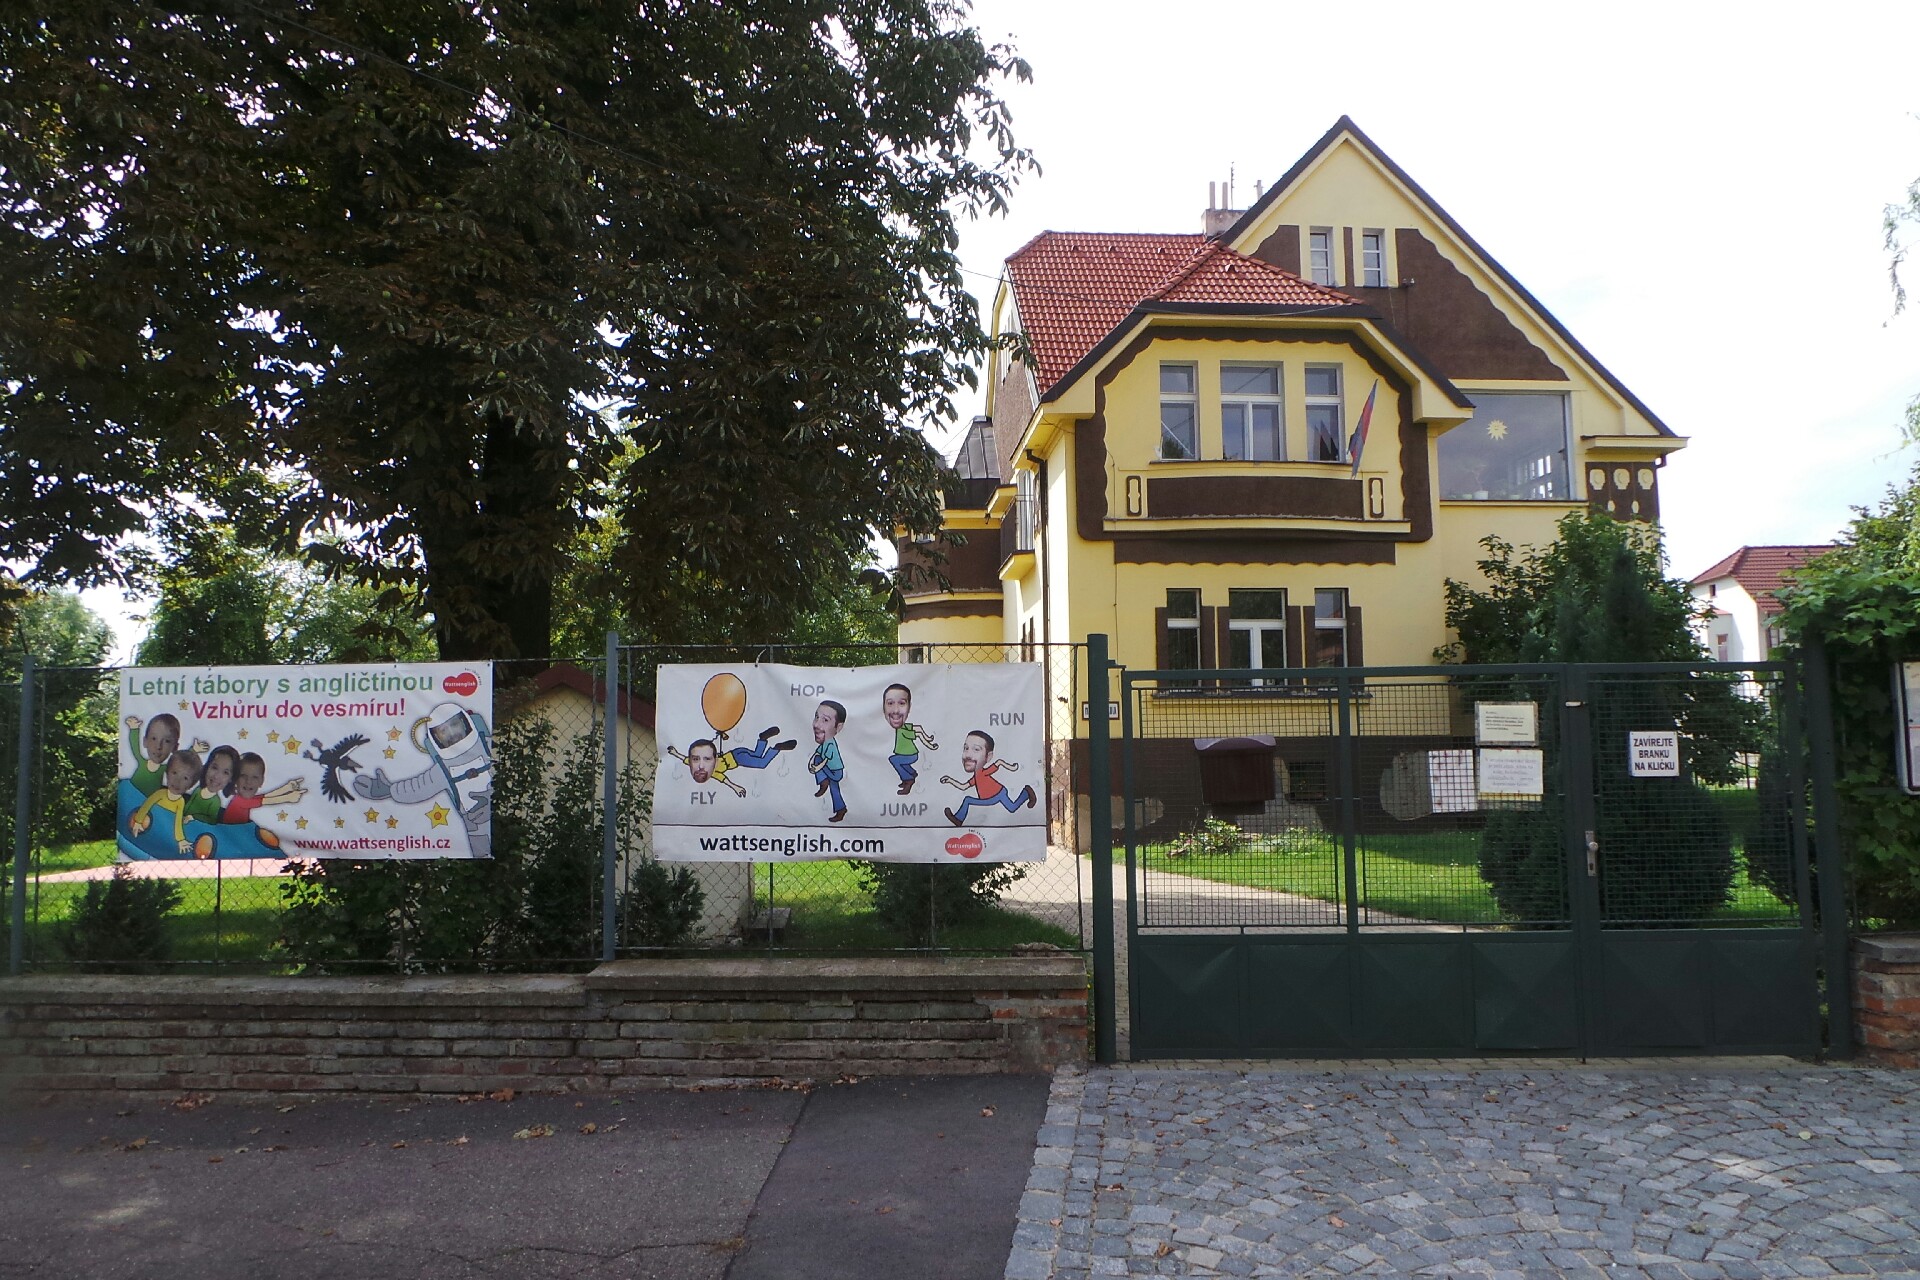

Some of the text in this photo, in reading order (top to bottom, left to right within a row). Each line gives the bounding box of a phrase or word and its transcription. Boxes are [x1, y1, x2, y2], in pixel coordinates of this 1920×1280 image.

[129, 671, 433, 699] Letní tábory s angličtinou
[790, 684, 825, 697] HOP
[192, 698, 405, 719] Vzhůru do vesmíru!
[989, 713, 1024, 726] RUN
[1633, 736, 1673, 747] ZAVÍREJTE
[1639, 750, 1670, 758] BRANKU
[1635, 759, 1675, 771] NA KLIČKU
[690, 791, 717, 805] FLY
[880, 803, 928, 817] JUMP
[294, 835, 451, 852] www.wattsenglish.cz
[700, 834, 884, 856] wattsenglish.com
